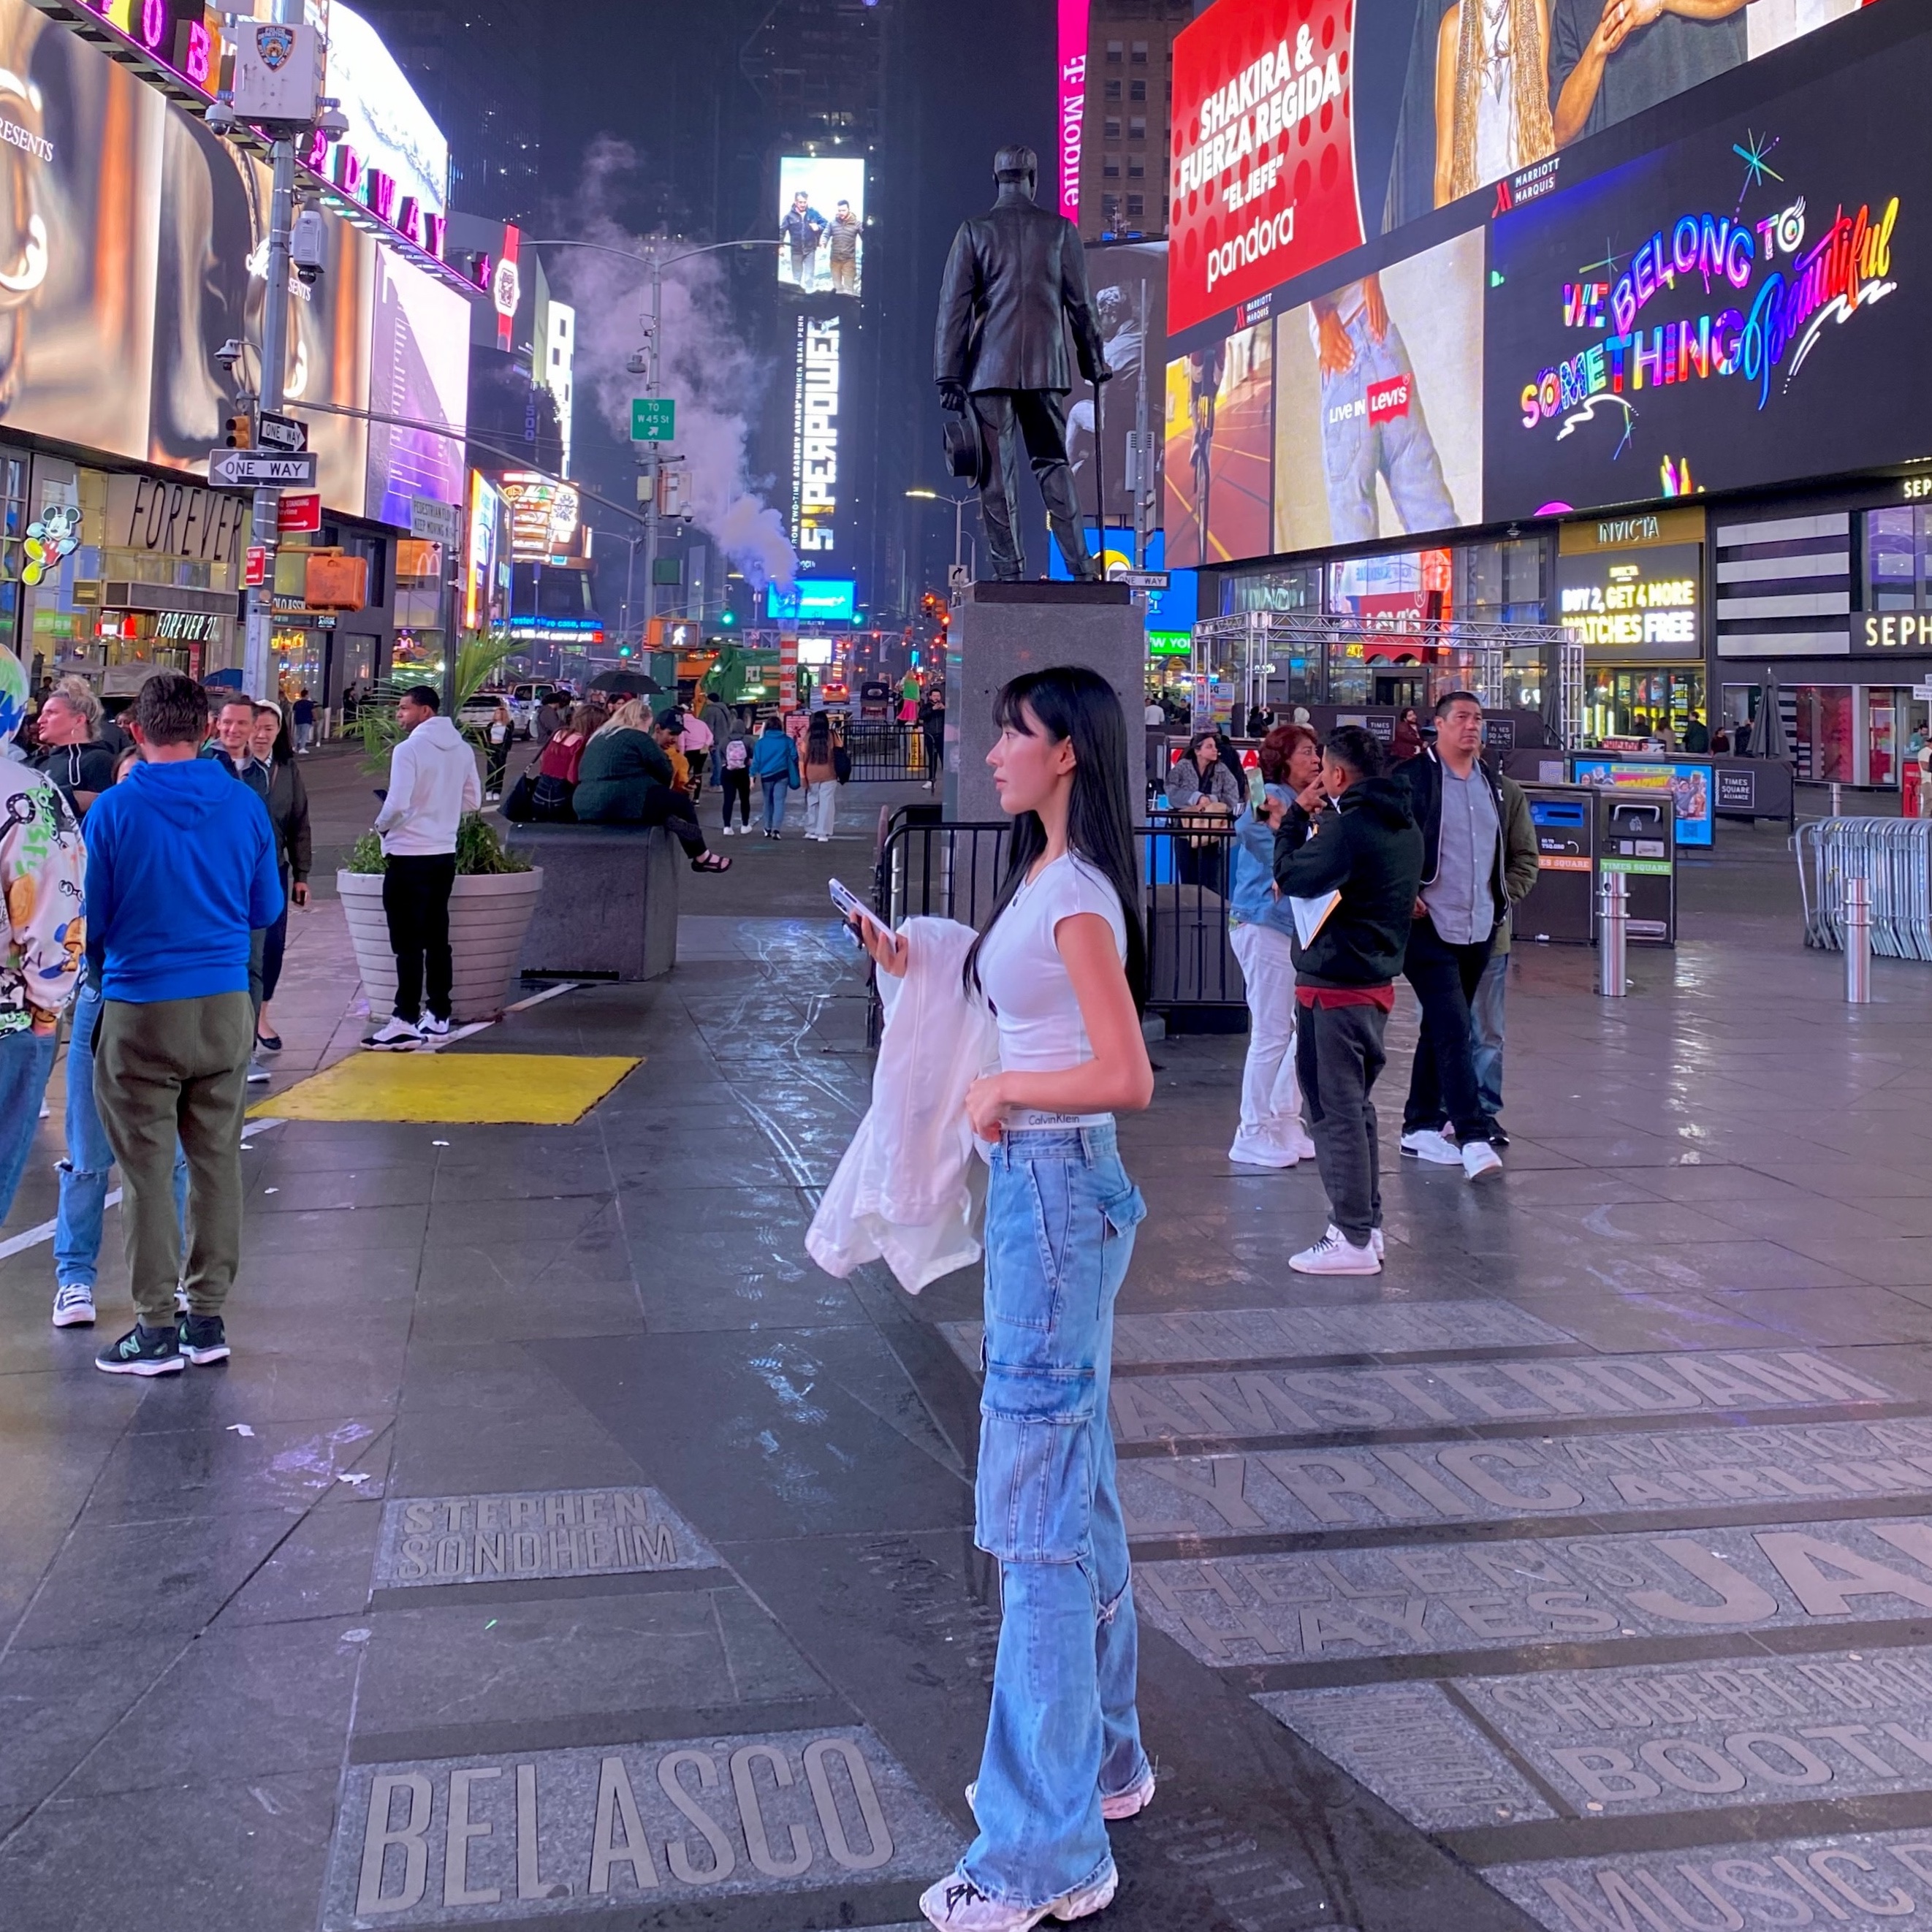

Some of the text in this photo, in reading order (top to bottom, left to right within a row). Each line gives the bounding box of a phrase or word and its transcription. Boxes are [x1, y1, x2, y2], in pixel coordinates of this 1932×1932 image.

[1200, 23, 1314, 141] SHAKIRA &
[1180, 53, 1341, 198] FUERZA REGIDA
[1515, 158, 1560, 188] MARRIOTT
[1515, 177, 1554, 204] MARQUIS
[1207, 205, 1294, 292] pandora
[1563, 195, 1806, 344] WE BELONG TO
[288, 278, 311, 301] SENTS
[1247, 293, 1272, 312] MARRIOTT
[1247, 307, 1269, 324] MARQUIS
[1521, 197, 1900, 429] SOMETHING Beautiful
[647, 403, 659, 411] TO
[661, 415, 669, 424] St
[1354, 400, 1366, 417] IN
[266, 423, 301, 446] ONE WAY
[225, 461, 303, 476] ONE WAY
[793, 437, 801, 477] ACADEMY
[128, 476, 245, 563] FOREVER
[1598, 516, 1659, 545] INVICTA
[1119, 576, 1163, 585] ONE WAY
[1562, 588, 1591, 612] BUY
[1605, 585, 1635, 609] GET
[1636, 583, 1647, 608] 4
[1648, 580, 1695, 607] MORE
[155, 612, 218, 641] FOREVER 21
[1644, 611, 1695, 643] FREE
[1722, 786, 1750, 794] SQUARE
[1724, 777, 1748, 786] TIMES
[1554, 859, 1589, 868] SQUARE
[1602, 862, 1670, 872] TIMES SQUARE
[1105, 1352, 1894, 1438] AMSTERDAM
[1562, 1421, 1932, 1473] AMERICA
[403, 1492, 650, 1534] STEPHEN
[398, 1524, 677, 1580] SONDHEIM
[1138, 1546, 1573, 1610] HELEN
[1181, 1591, 1621, 1659] HAYES
[1489, 1666, 1811, 1735] SHUBERT
[355, 1737, 896, 1916] BELASCO
[1537, 1847, 1917, 1932] MUSIC
